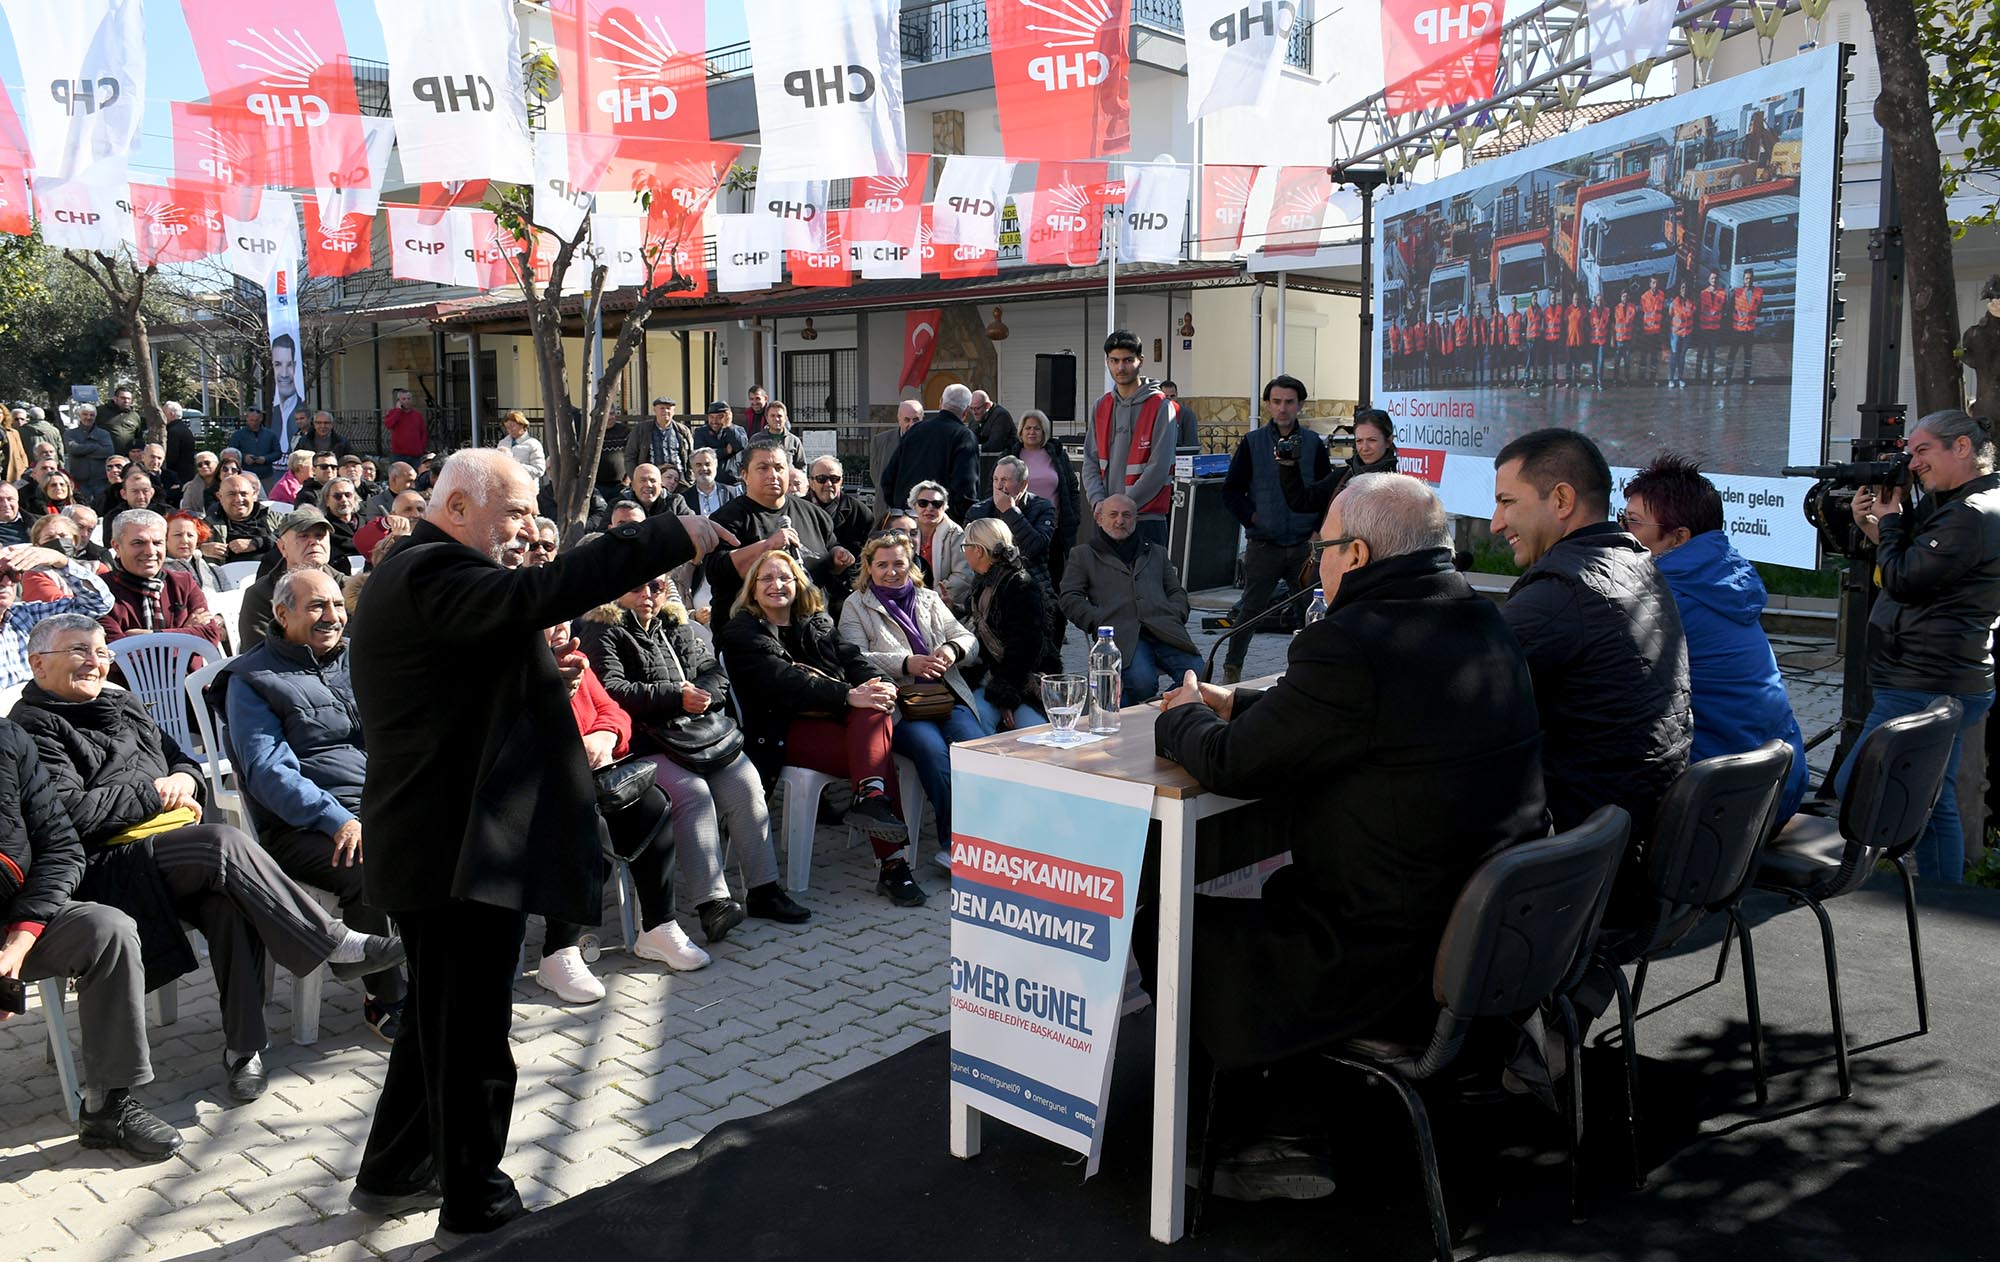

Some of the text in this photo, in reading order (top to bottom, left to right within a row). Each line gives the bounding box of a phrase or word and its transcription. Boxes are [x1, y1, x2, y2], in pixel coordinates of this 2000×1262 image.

[55, 210, 101, 226] CHP
[1001, 219, 1021, 232] ILIK
[150, 224, 188, 236] CHP
[237, 237, 277, 255] CHP
[322, 239, 358, 253] CHP
[405, 239, 445, 255] CHP
[873, 247, 910, 261] CHP
[954, 246, 986, 260] CHP
[732, 252, 770, 266] CHP
[807, 254, 841, 268] CHP
[1388, 396, 1475, 418] Acil Sorunlara
[1748, 490, 1784, 509] gelen
[1731, 516, 1771, 537] çözdü.
[951, 842, 1115, 903] AN BAŞKANIMIZ
[988, 899, 1096, 950] ADAYIMIZ
[1015, 977, 1093, 1036] GÜNEL
[988, 1008, 1029, 1032] BELEDİYE
[1030, 1022, 1066, 1045] BAŞKAN
[1065, 1035, 1092, 1054] ADAYI
[1032, 1093, 1068, 1115] omergunel
